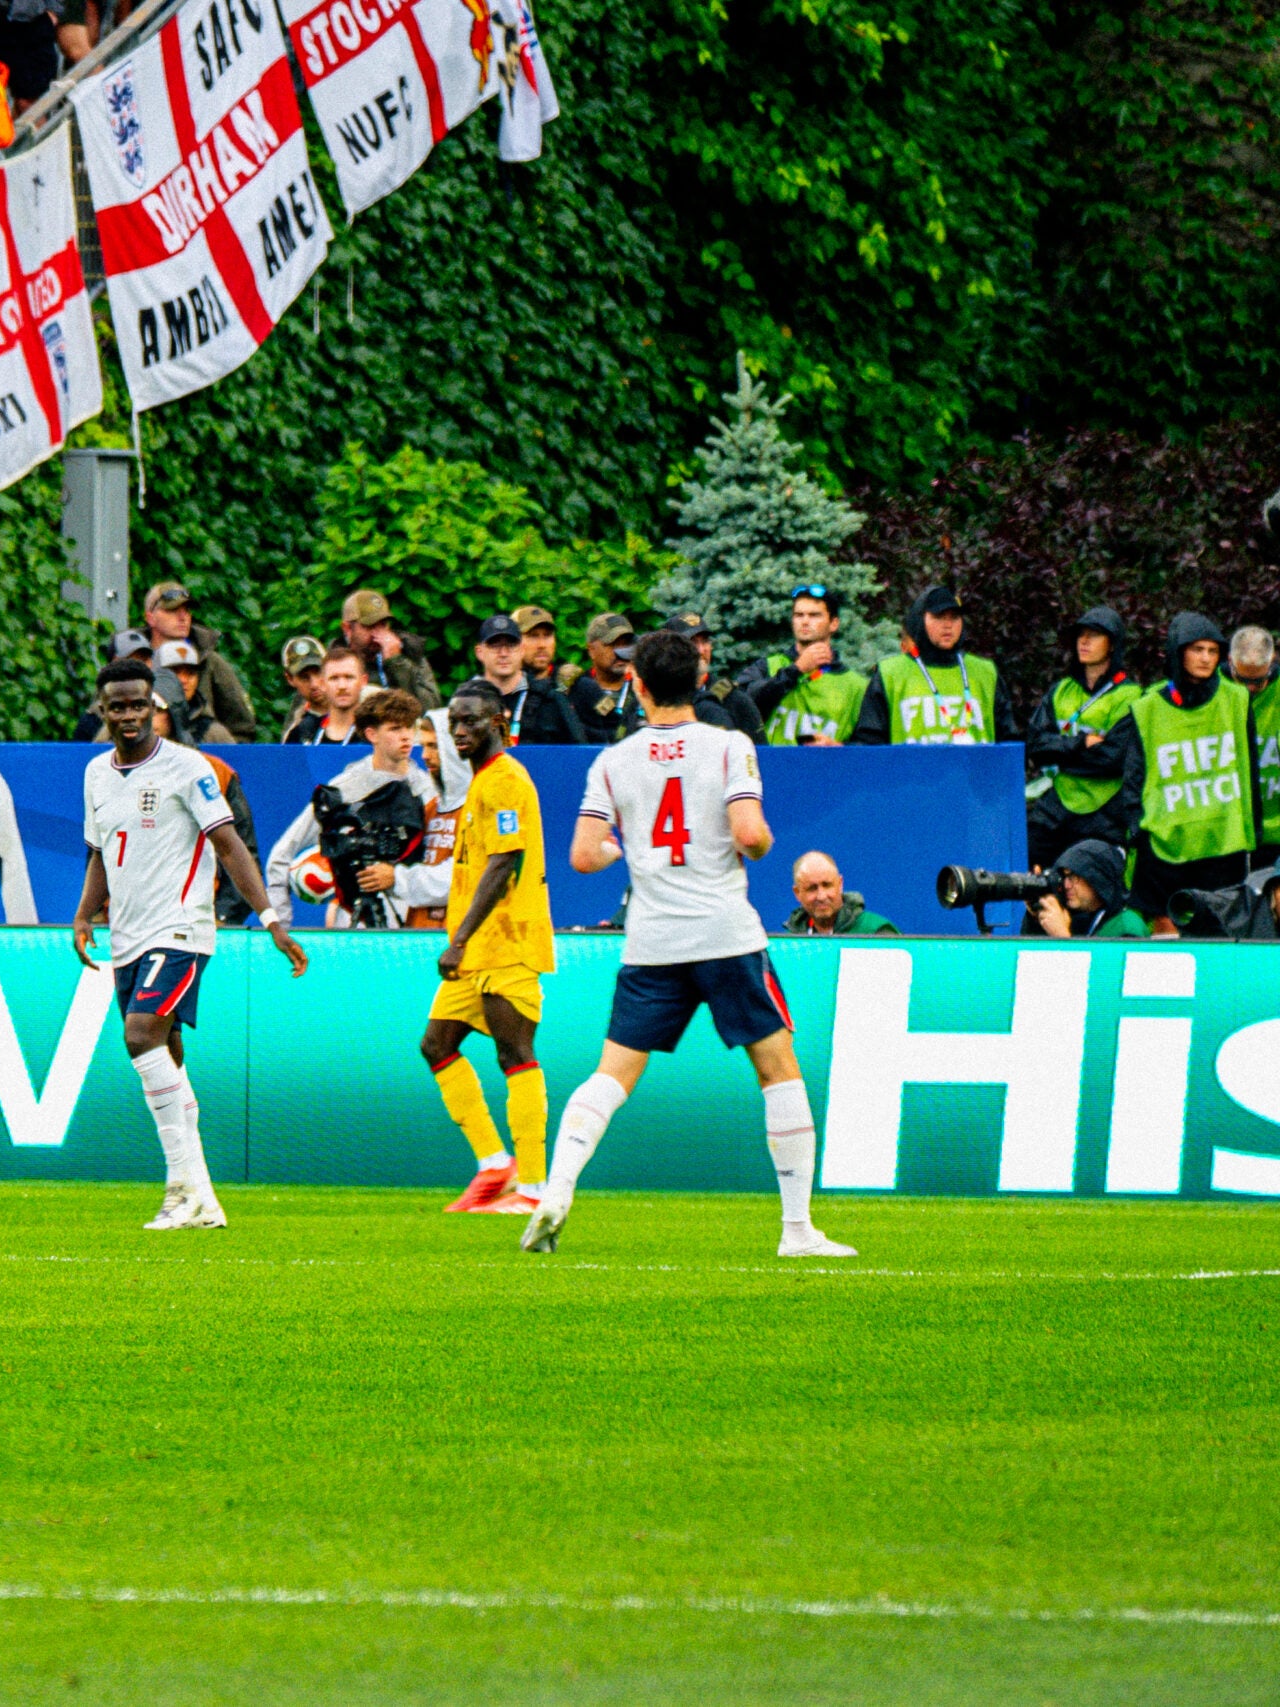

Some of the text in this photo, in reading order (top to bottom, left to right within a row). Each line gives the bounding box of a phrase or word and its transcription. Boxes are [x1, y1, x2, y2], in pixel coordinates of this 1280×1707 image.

[336, 75, 412, 164] NUFC
[141, 88, 280, 254] DURHAM
[900, 695, 984, 733] FIFA
[649, 739, 686, 761] RICE
[1157, 731, 1237, 780] FIFA
[650, 775, 691, 867] 4
[116, 831, 128, 867] 7
[143, 953, 167, 989] 7
